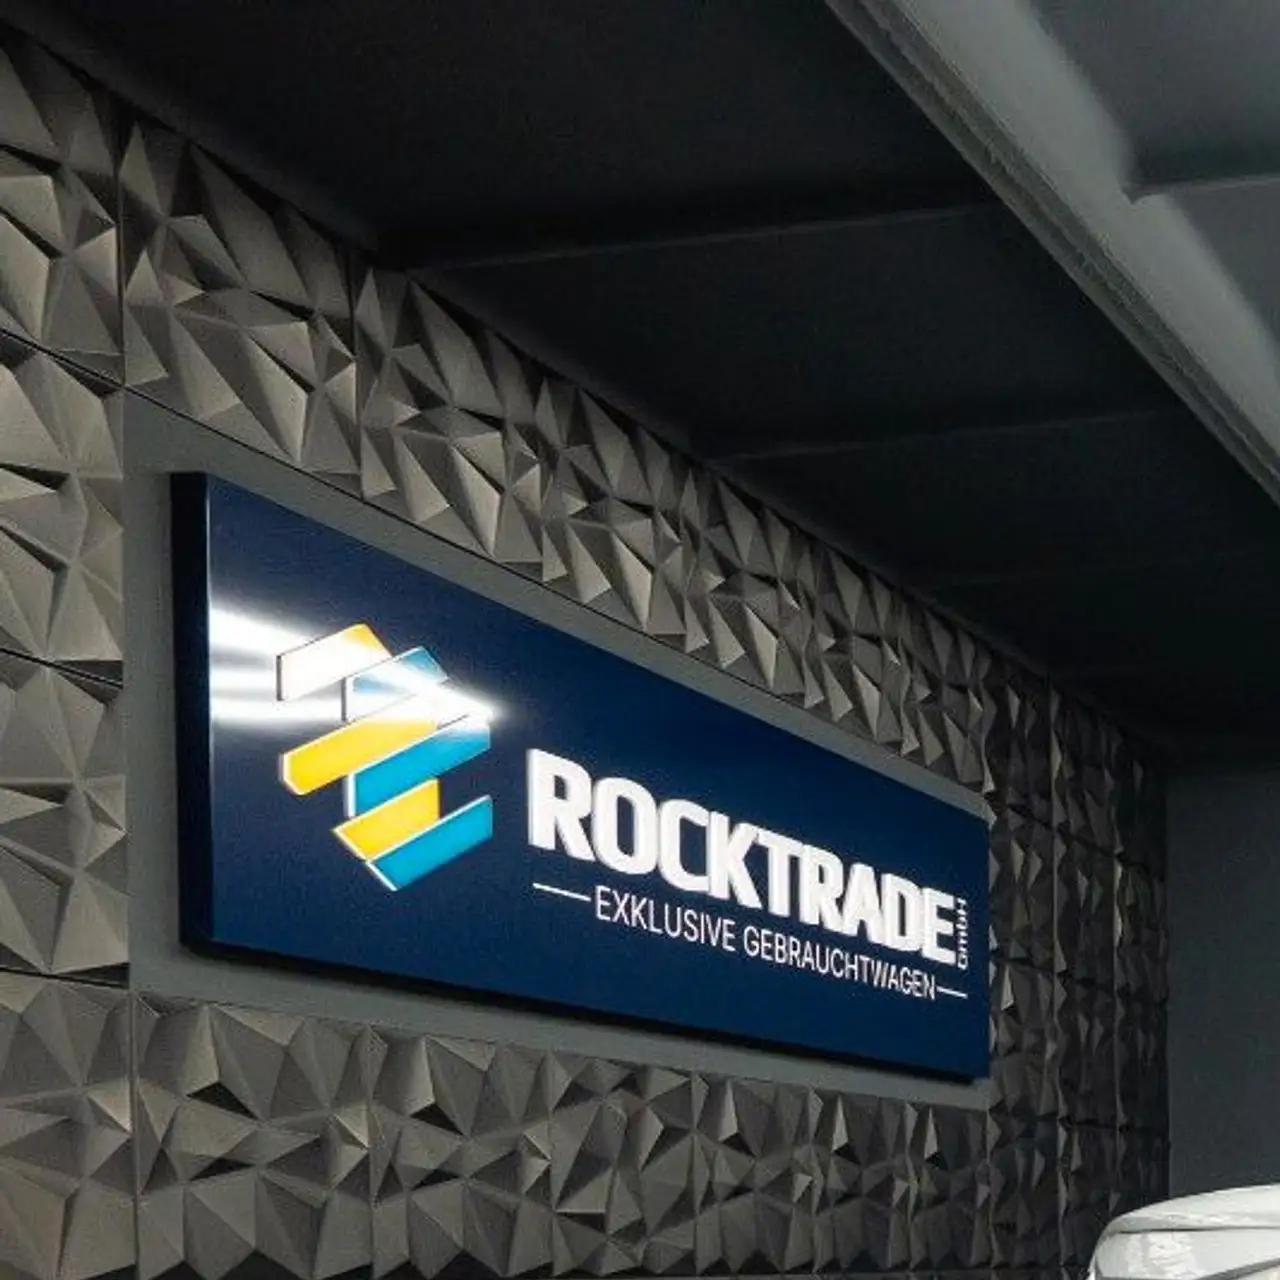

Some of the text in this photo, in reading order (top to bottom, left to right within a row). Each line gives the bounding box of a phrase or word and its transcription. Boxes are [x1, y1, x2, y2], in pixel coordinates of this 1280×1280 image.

[526, 748, 958, 965] ROCKTRADE
[595, 885, 936, 1000] EXKLUSIVE GEBRAUCHTWAGEN
